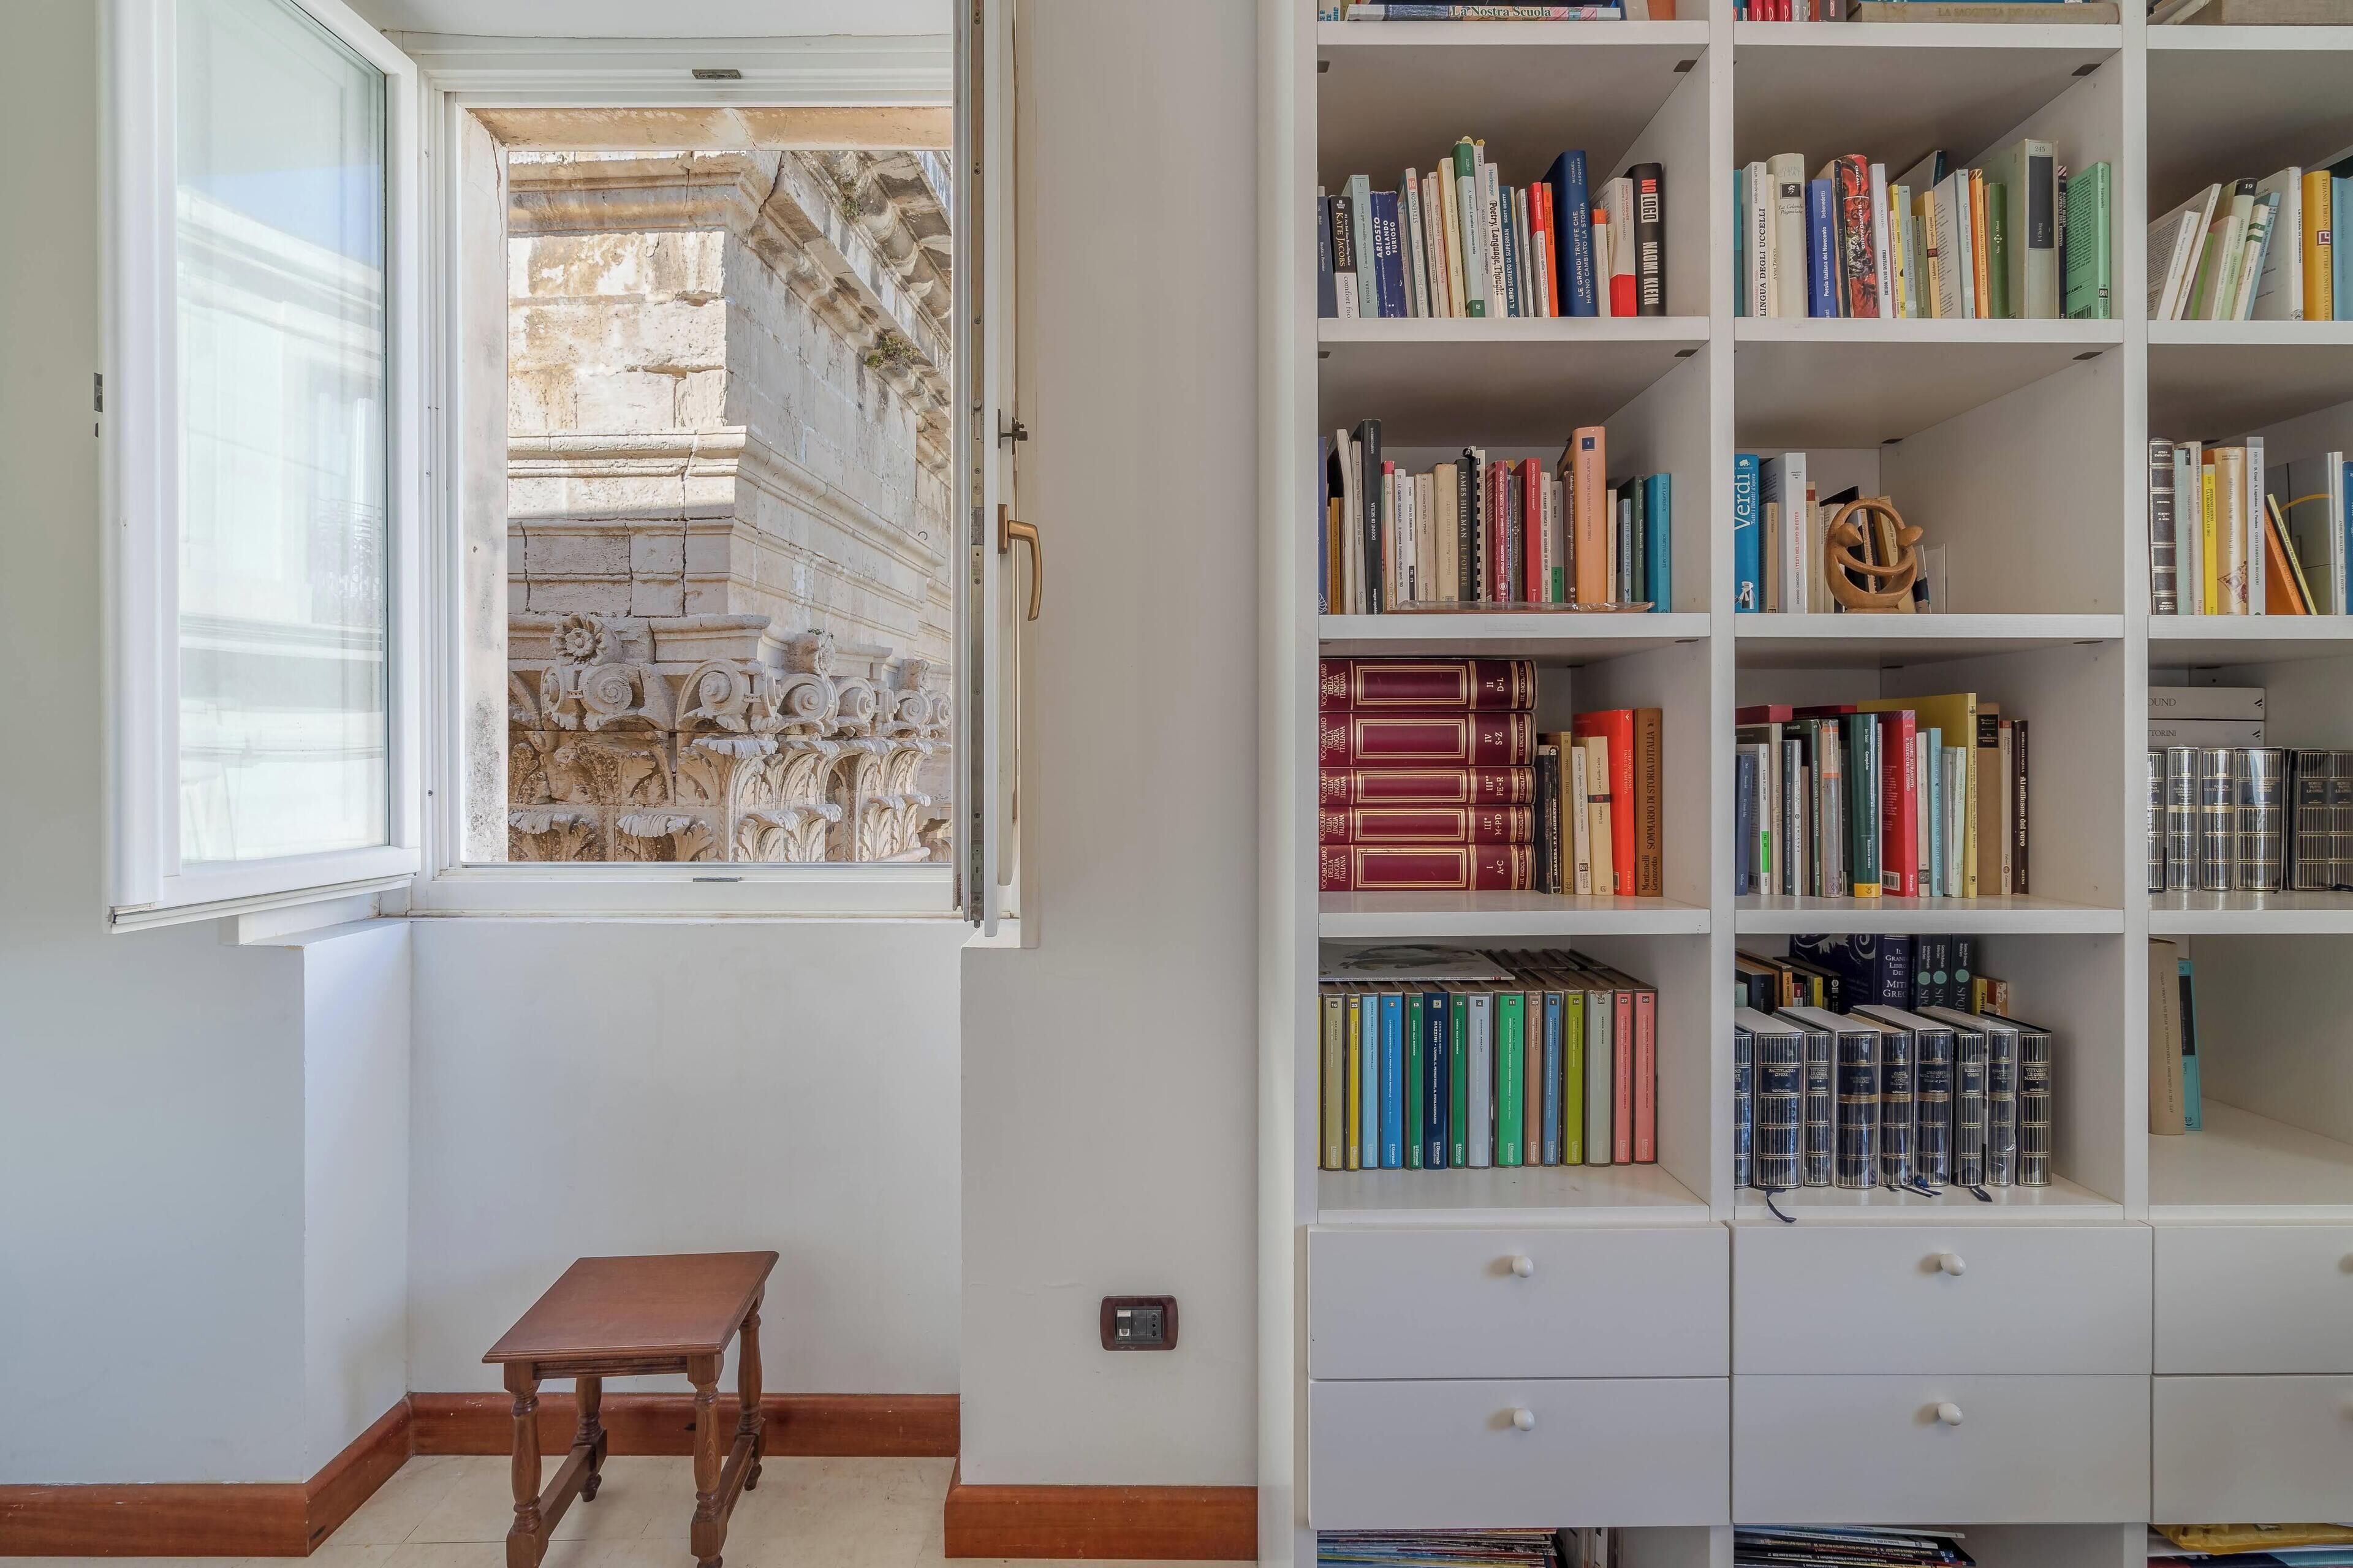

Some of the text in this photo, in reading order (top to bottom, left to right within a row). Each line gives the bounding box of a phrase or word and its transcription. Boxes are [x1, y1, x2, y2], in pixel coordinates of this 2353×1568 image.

[1452, 6, 1552, 17] La Nostra Scuola
[1642, 178, 1658, 222] NO LOGO
[1786, 203, 1805, 212] Colomba
[1374, 217, 1383, 258] ARIOSTO
[1490, 200, 1505, 296] Poetry, Language, Thought
[1582, 230, 1588, 240] LA
[1336, 237, 1346, 267] JACOBS
[1643, 241, 1659, 305] NAOMI KLEIN
[1735, 473, 1751, 531] Verdi
[1485, 733, 1492, 743] IV
[1496, 776, 1504, 796] PE-R
[1645, 731, 1655, 850] SOMMARIO DI STORIA D'ITALIA
[2020, 776, 2026, 785] Al
[1642, 855, 1650, 891] Montanelli
[1650, 856, 1659, 891] Granzotto
[1886, 980, 1907, 988] MITI
